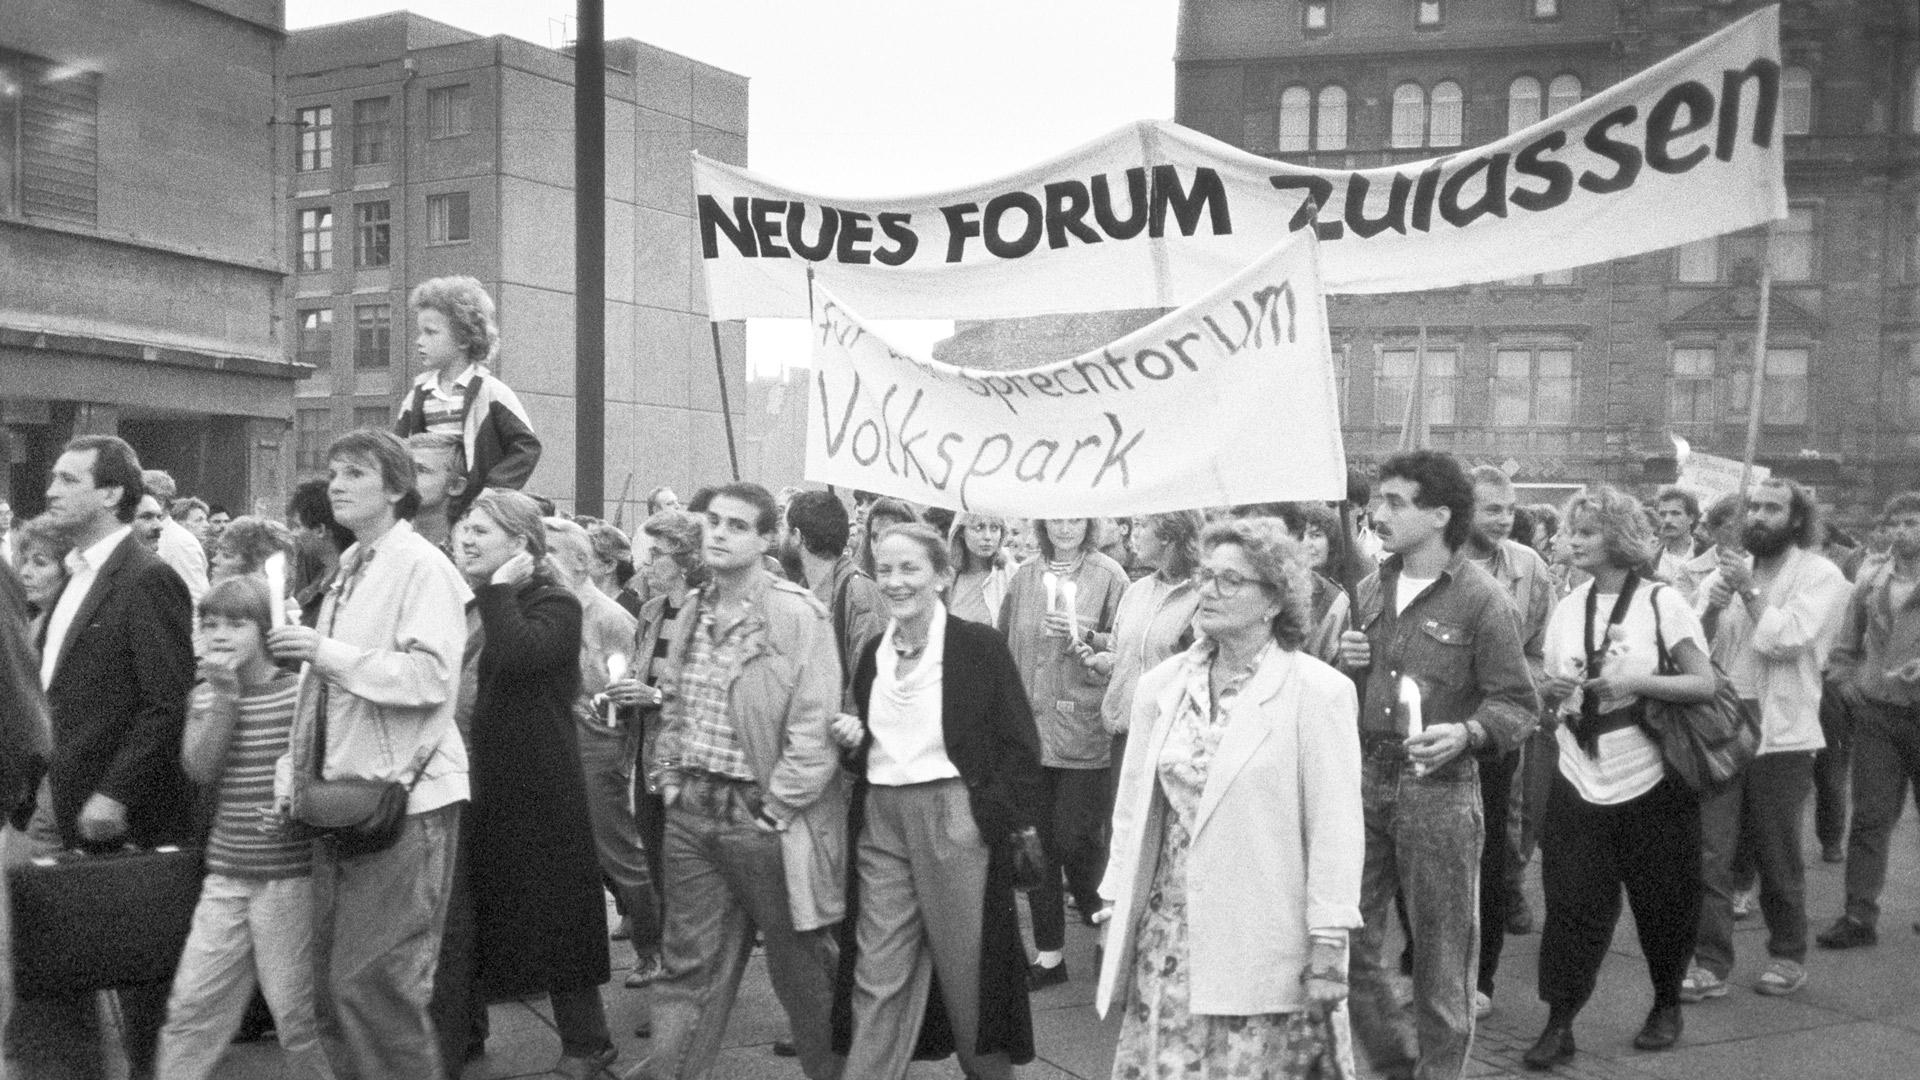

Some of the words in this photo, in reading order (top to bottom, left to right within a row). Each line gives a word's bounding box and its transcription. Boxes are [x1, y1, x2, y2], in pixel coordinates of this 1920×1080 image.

[697, 194, 919, 266] NEUES
[939, 164, 1233, 263] FORUM
[818, 369, 1145, 512] Volkspark
